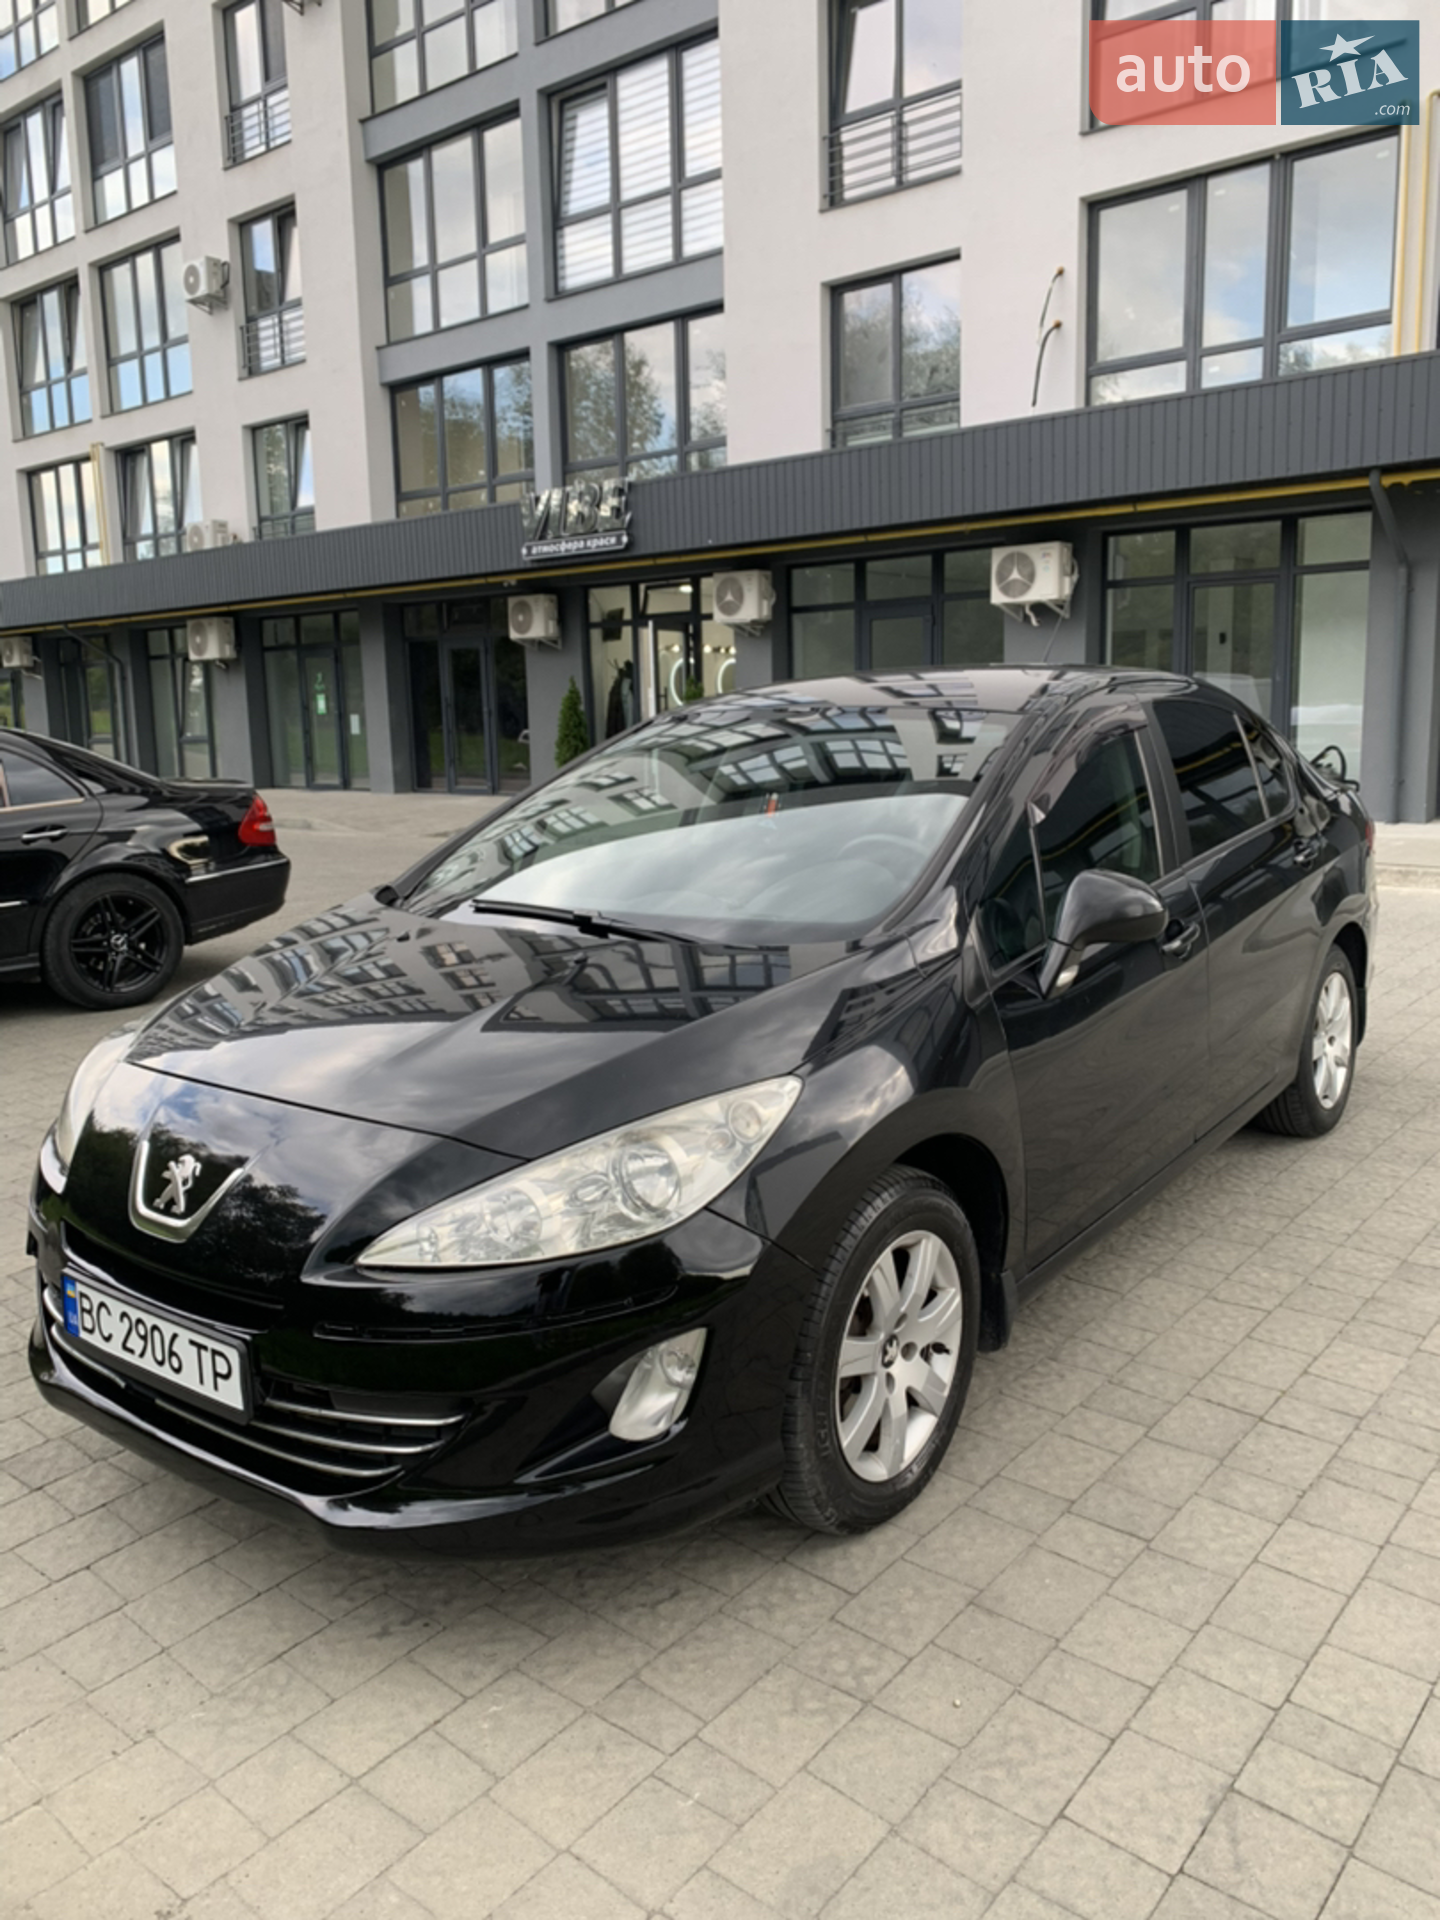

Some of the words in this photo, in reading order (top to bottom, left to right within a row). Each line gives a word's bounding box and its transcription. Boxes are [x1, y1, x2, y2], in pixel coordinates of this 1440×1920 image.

[521, 479, 631, 540] VIBE
[79, 1291, 113, 1343] BC
[119, 1312, 184, 1375] 2906
[188, 1338, 232, 1392] TP
